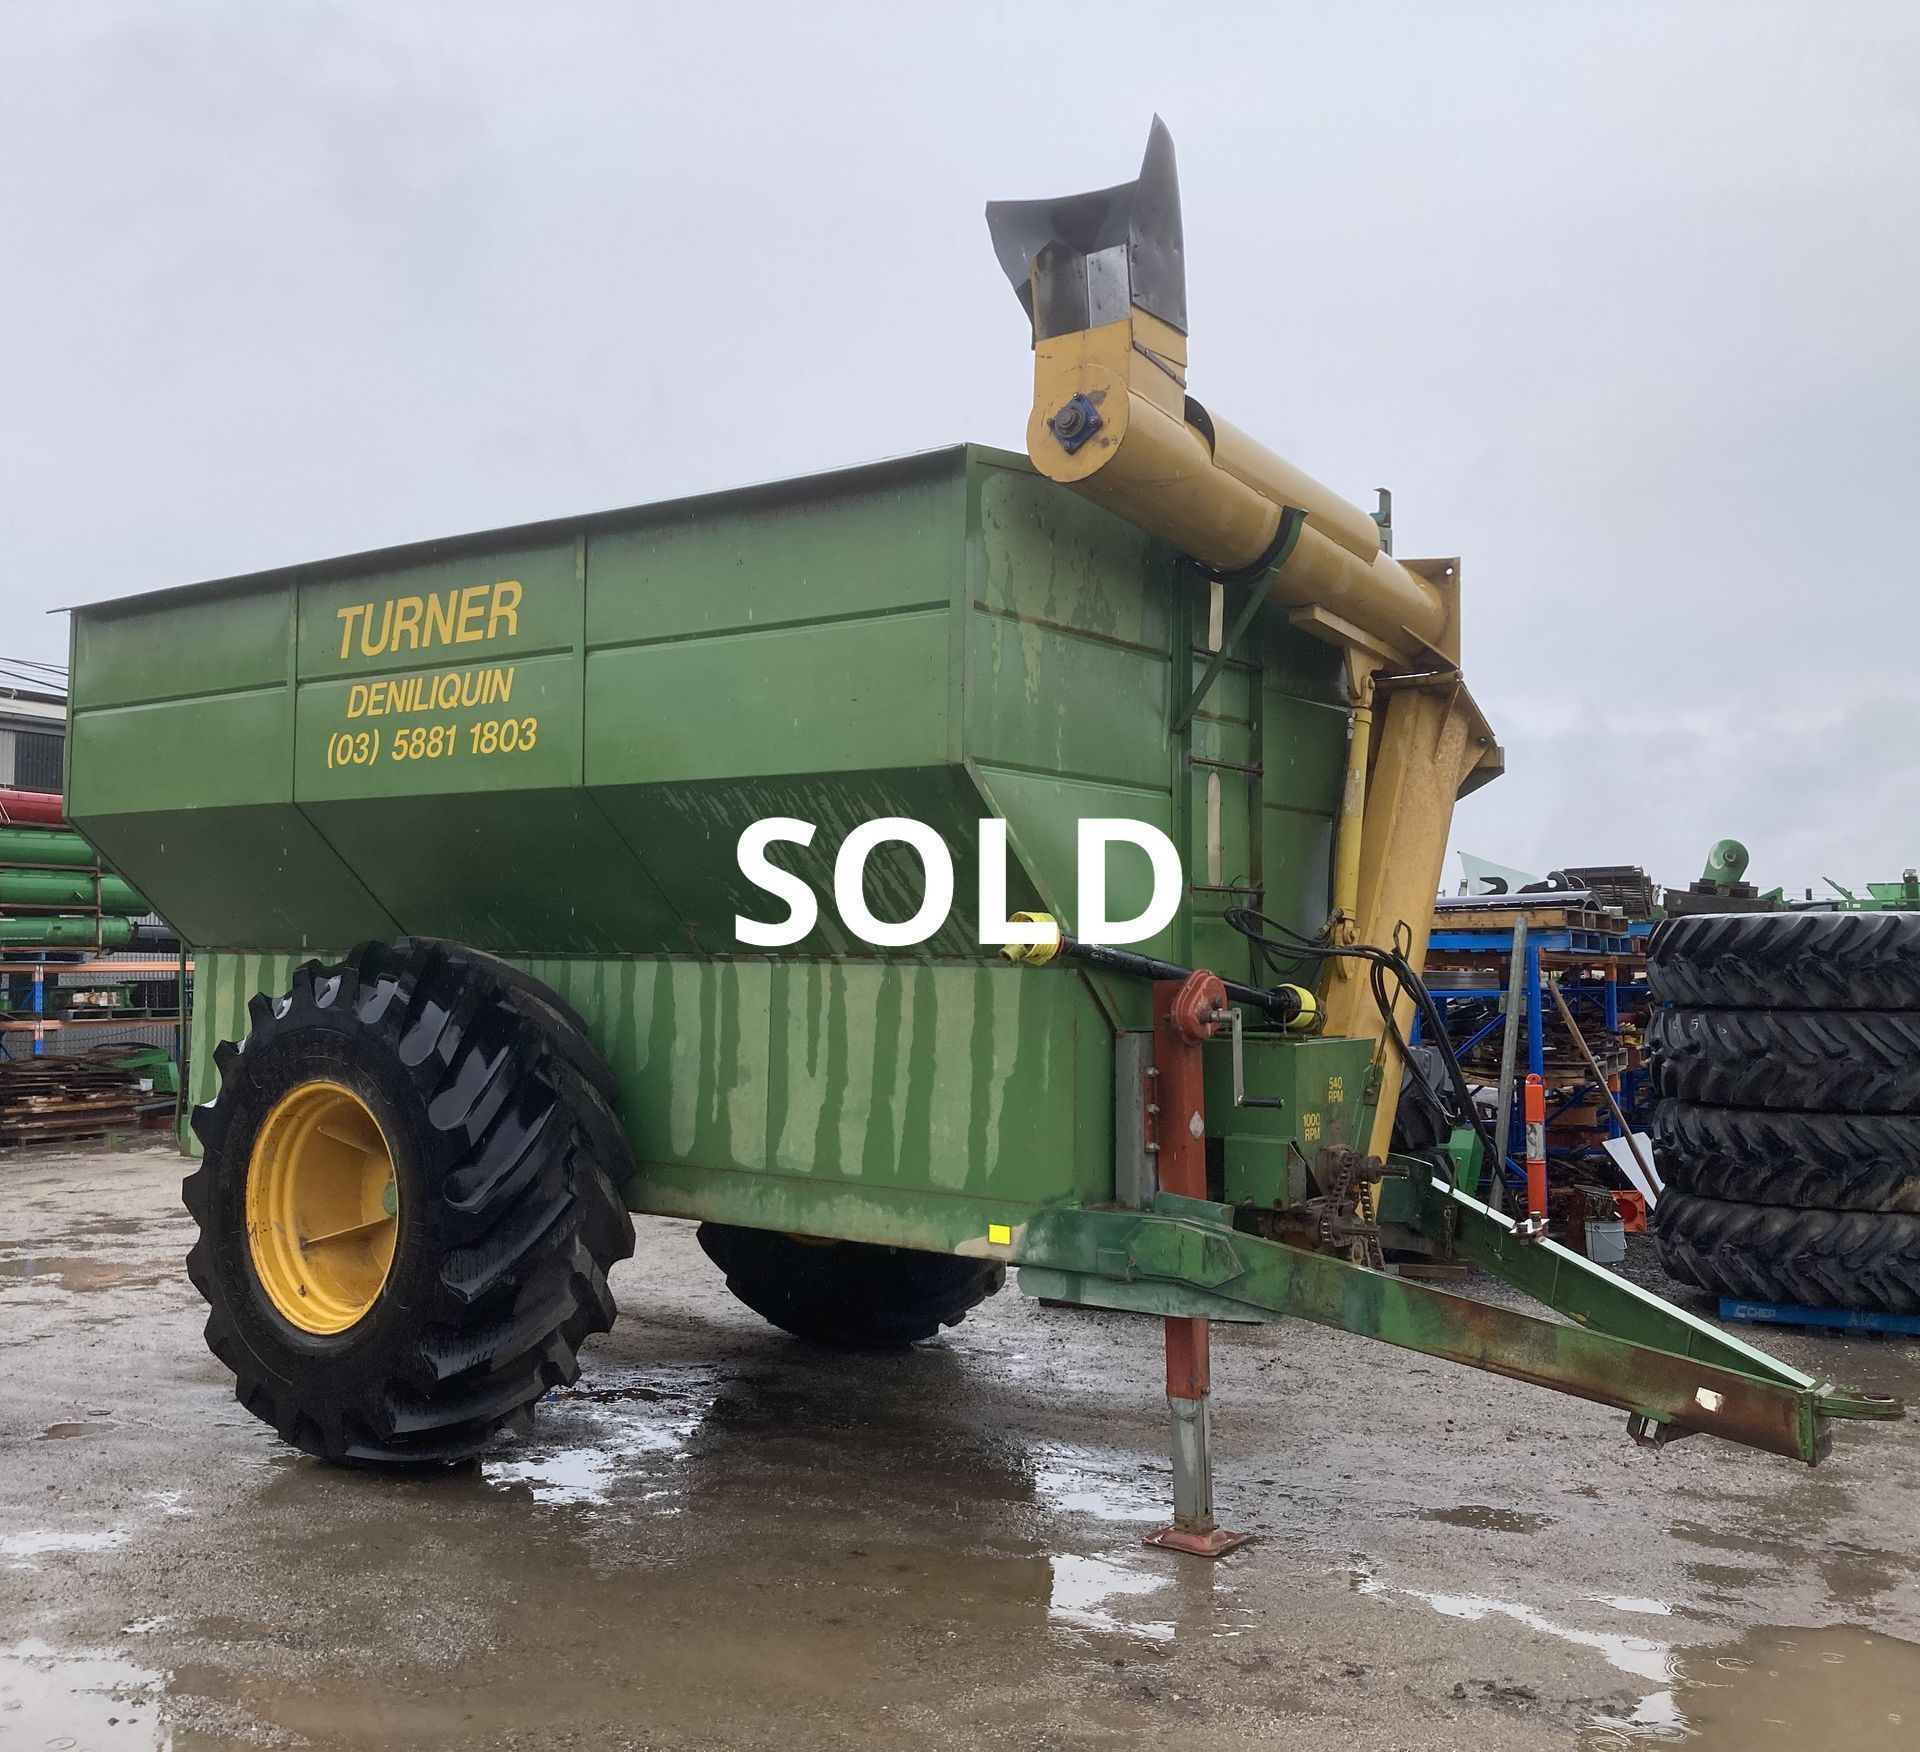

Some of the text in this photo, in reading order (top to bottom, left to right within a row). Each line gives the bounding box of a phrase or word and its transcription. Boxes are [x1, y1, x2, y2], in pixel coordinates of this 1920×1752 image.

[336, 580, 523, 659] TURNER
[347, 667, 515, 718] DENILIQUIN
[327, 717, 538, 769] (03) 5881 1803
[1328, 1076, 1343, 1090] 540
[1328, 1090, 1344, 1104] RPM
[1304, 1127, 1320, 1141] RPM
